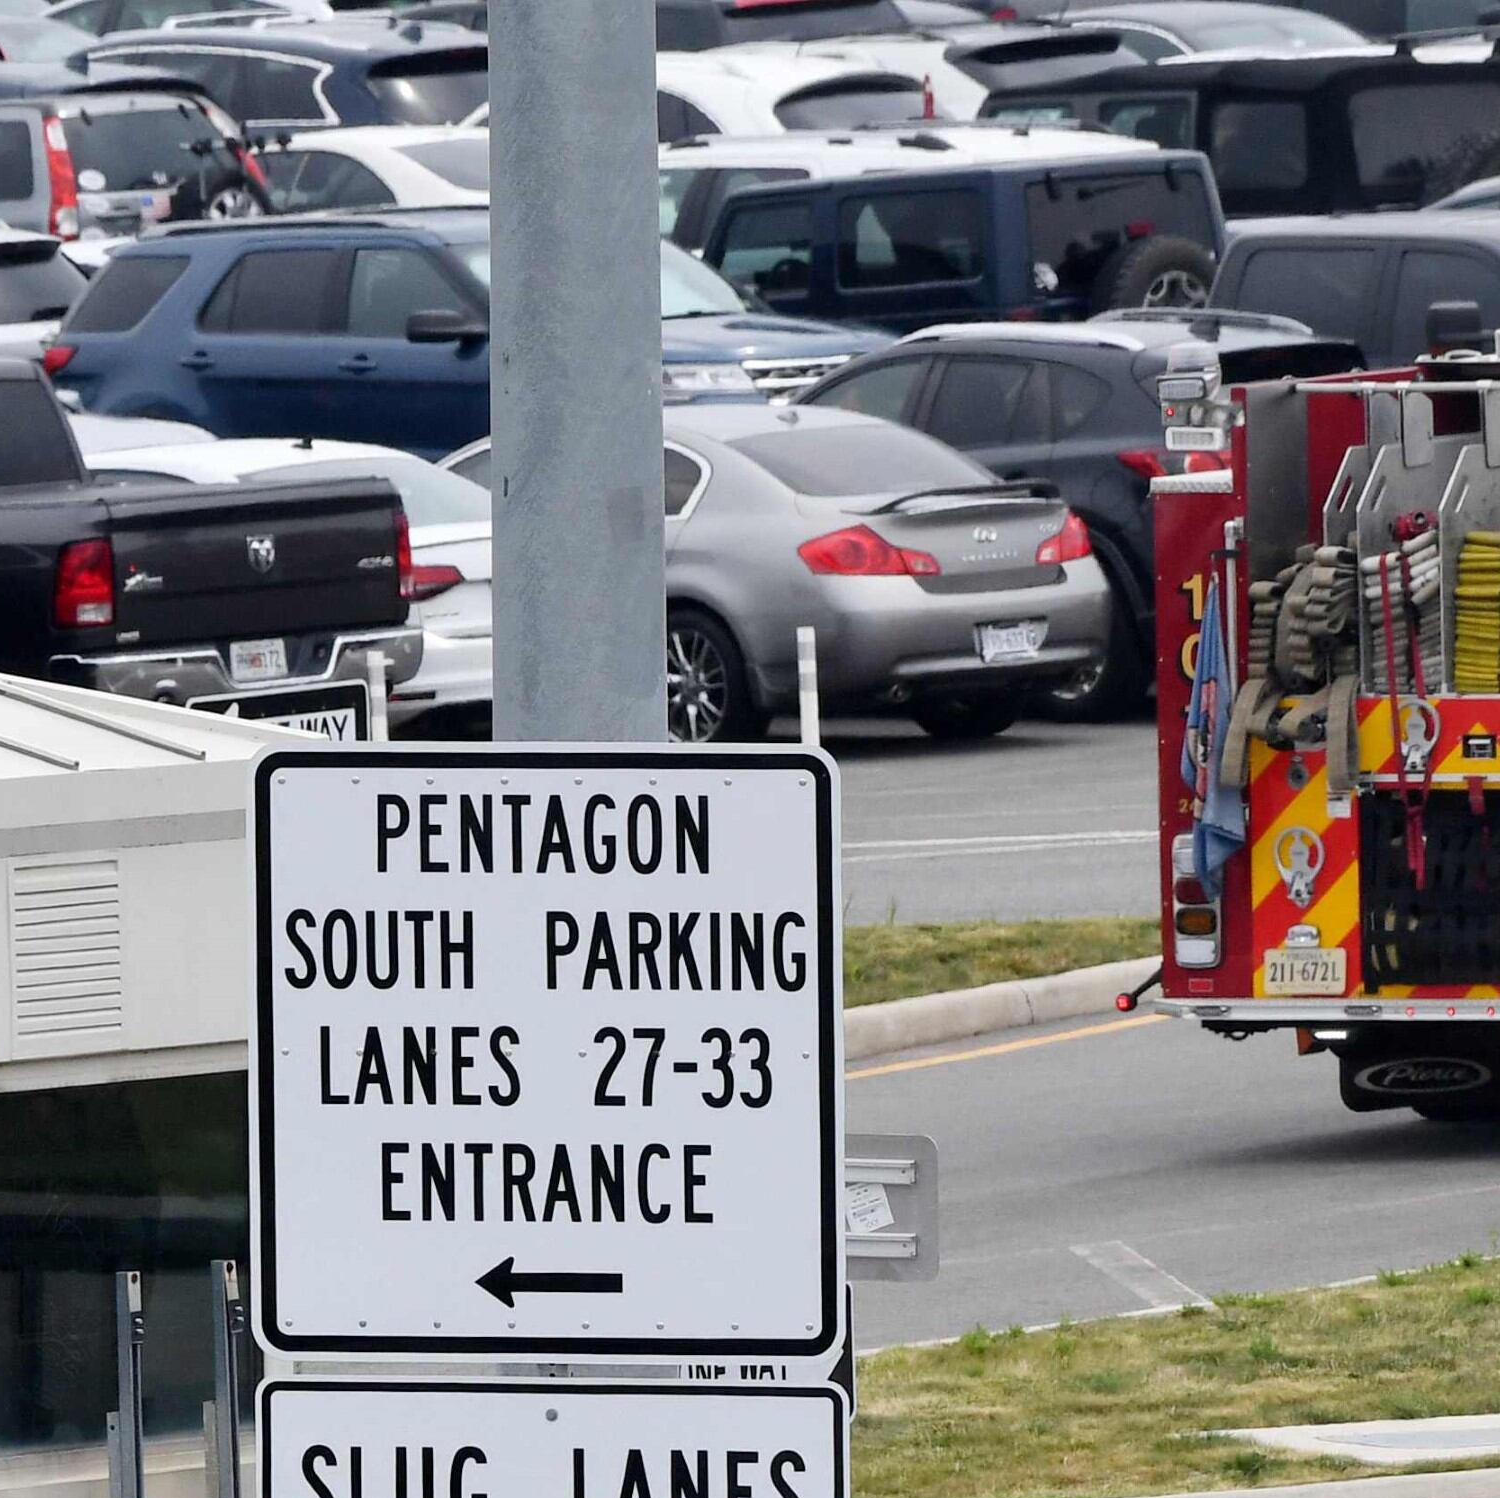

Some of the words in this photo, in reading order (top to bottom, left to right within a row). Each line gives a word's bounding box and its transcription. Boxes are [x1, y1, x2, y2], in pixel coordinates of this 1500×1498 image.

[377, 793, 710, 875] PENTAGON
[284, 908, 475, 990] SOUTH
[546, 911, 807, 992] PARKING
[320, 1025, 522, 1107] LANES
[593, 1026, 774, 1109] 27-33
[381, 1142, 715, 1225] ENTRANCE
